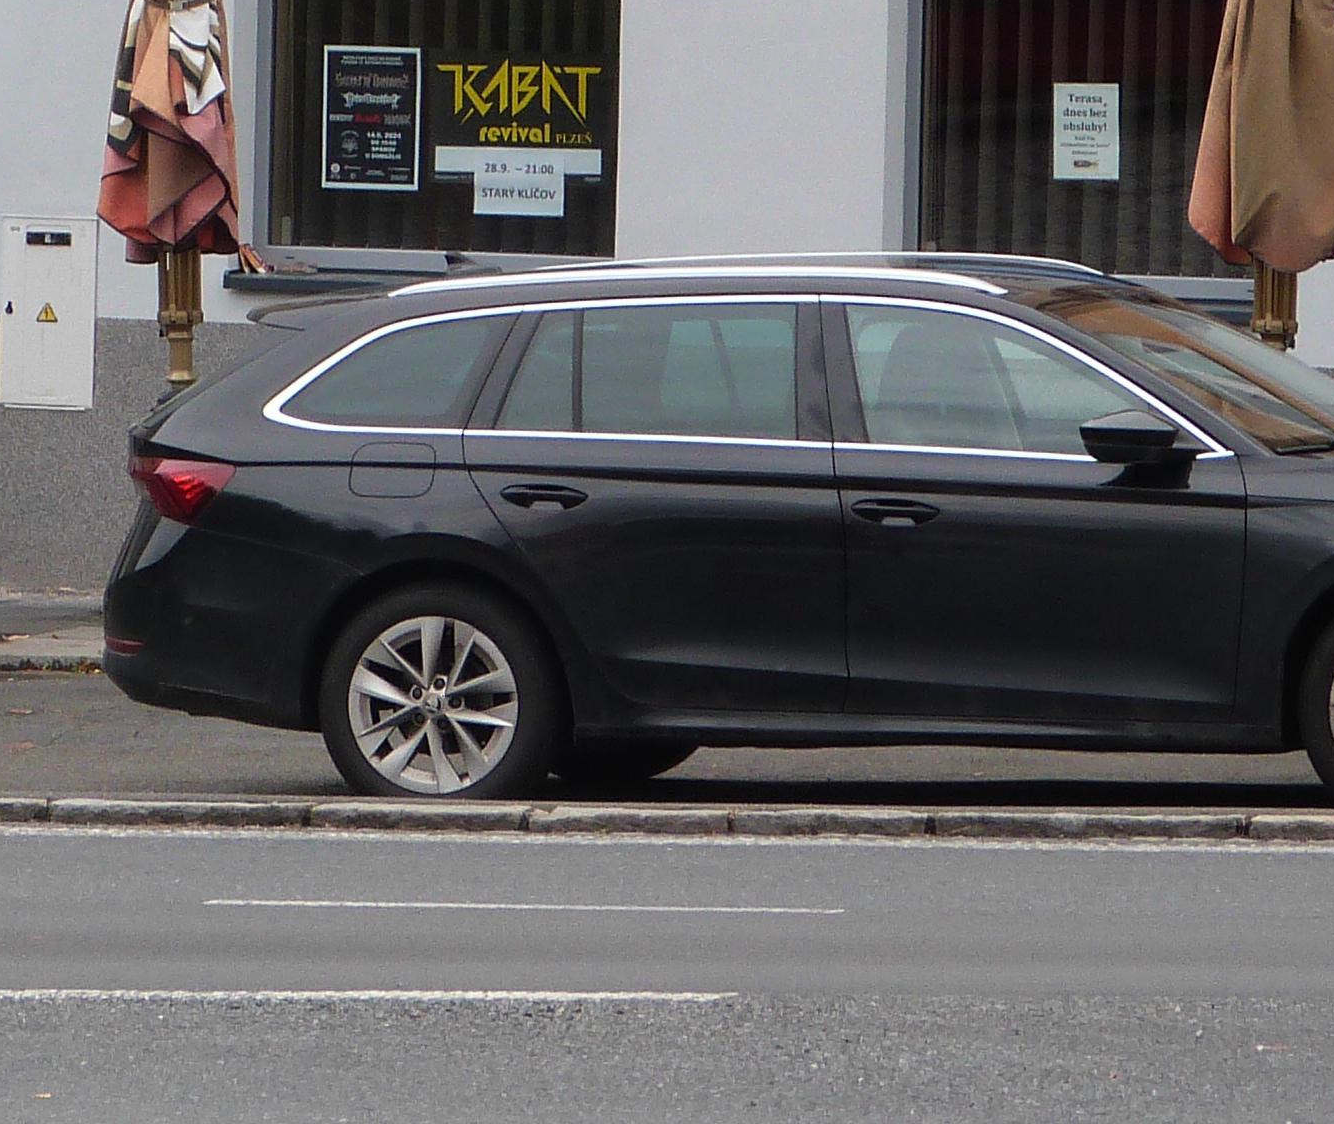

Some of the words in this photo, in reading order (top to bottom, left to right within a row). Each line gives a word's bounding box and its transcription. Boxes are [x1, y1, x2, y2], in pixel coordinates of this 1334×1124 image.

[1068, 93, 1103, 103] Terasa
[1063, 107, 1087, 117] dnes
[1089, 107, 1107, 117] bez
[479, 121, 551, 143] revival
[555, 132, 593, 144] PLZEŇ
[484, 163, 510, 174] 28.9.
[525, 165, 555, 175] 21:00
[482, 187, 515, 198] STARÝ
[517, 187, 556, 200] KLÍČOV
